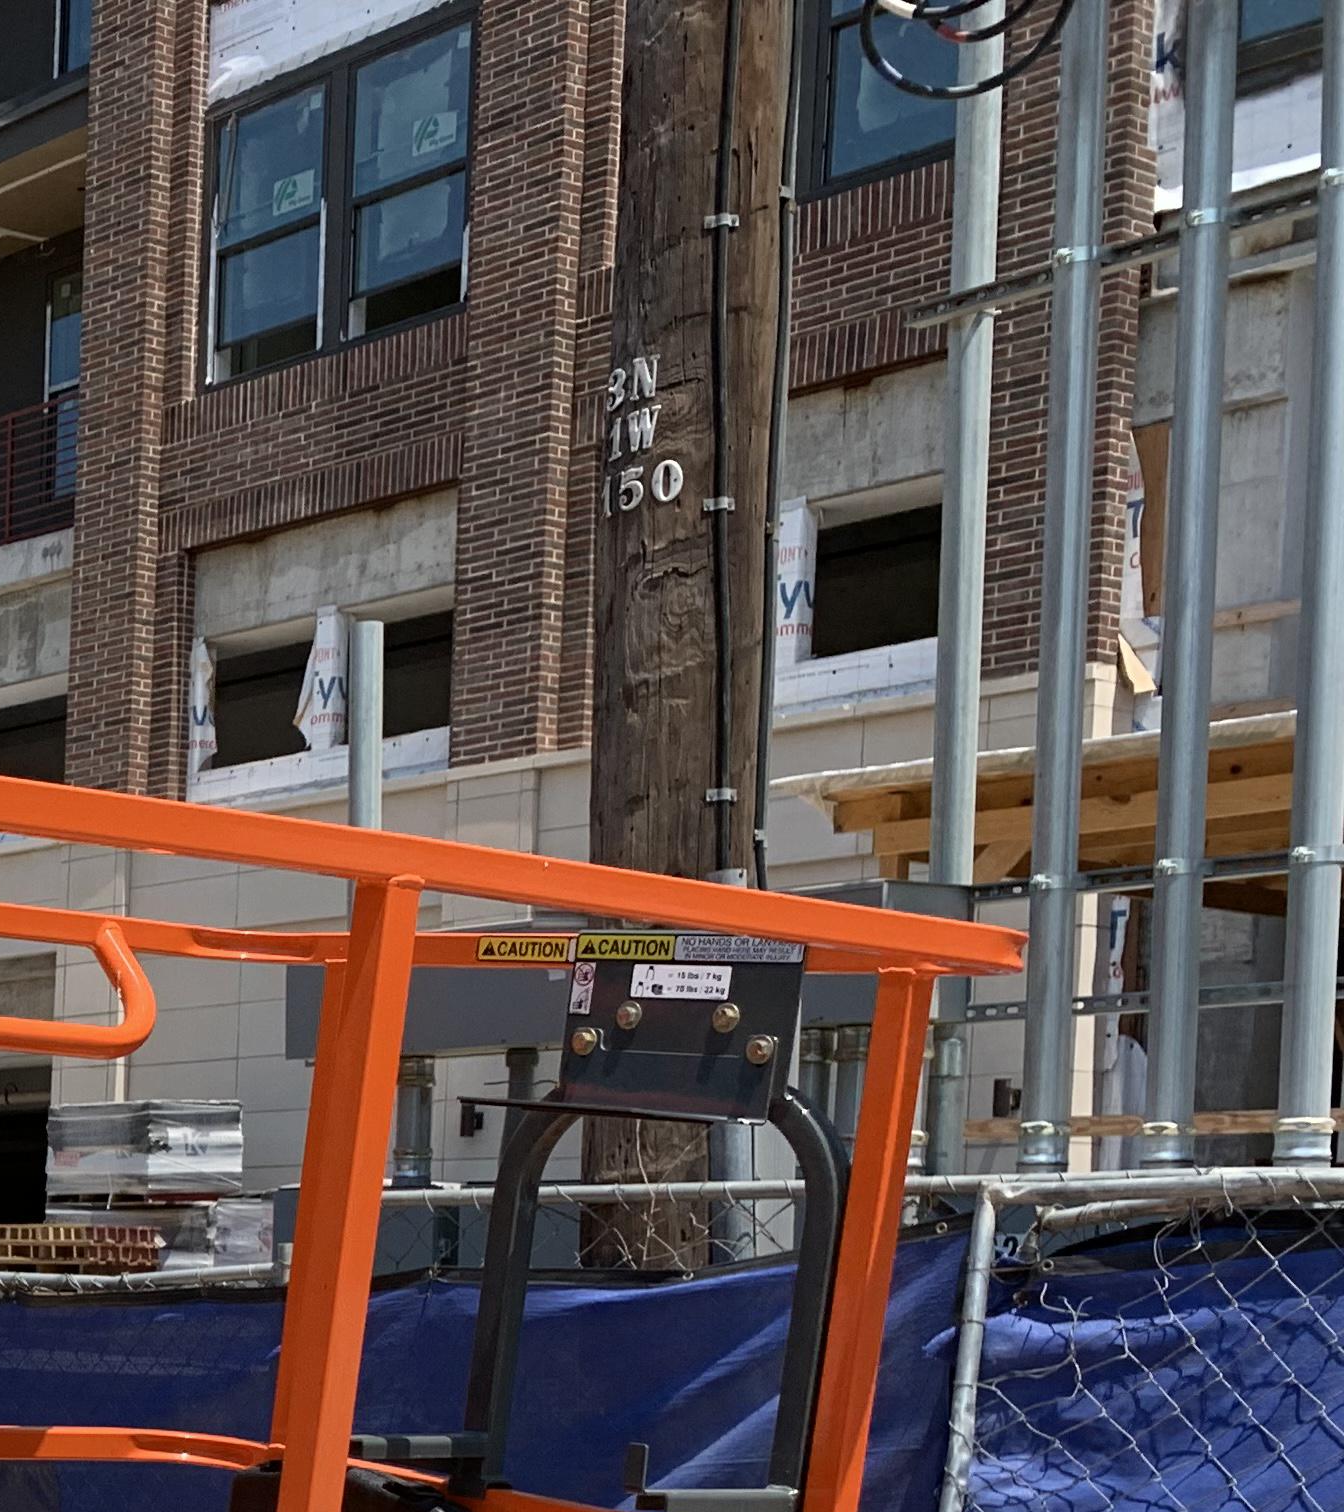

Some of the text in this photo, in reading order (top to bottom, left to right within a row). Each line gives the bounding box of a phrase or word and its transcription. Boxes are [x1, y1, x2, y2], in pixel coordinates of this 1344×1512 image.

[606, 354, 661, 412] 3N
[608, 404, 662, 463] 1W
[600, 459, 684, 518] 150
[497, 941, 563, 958] CAUTION
[598, 940, 670, 957] CAUTION
